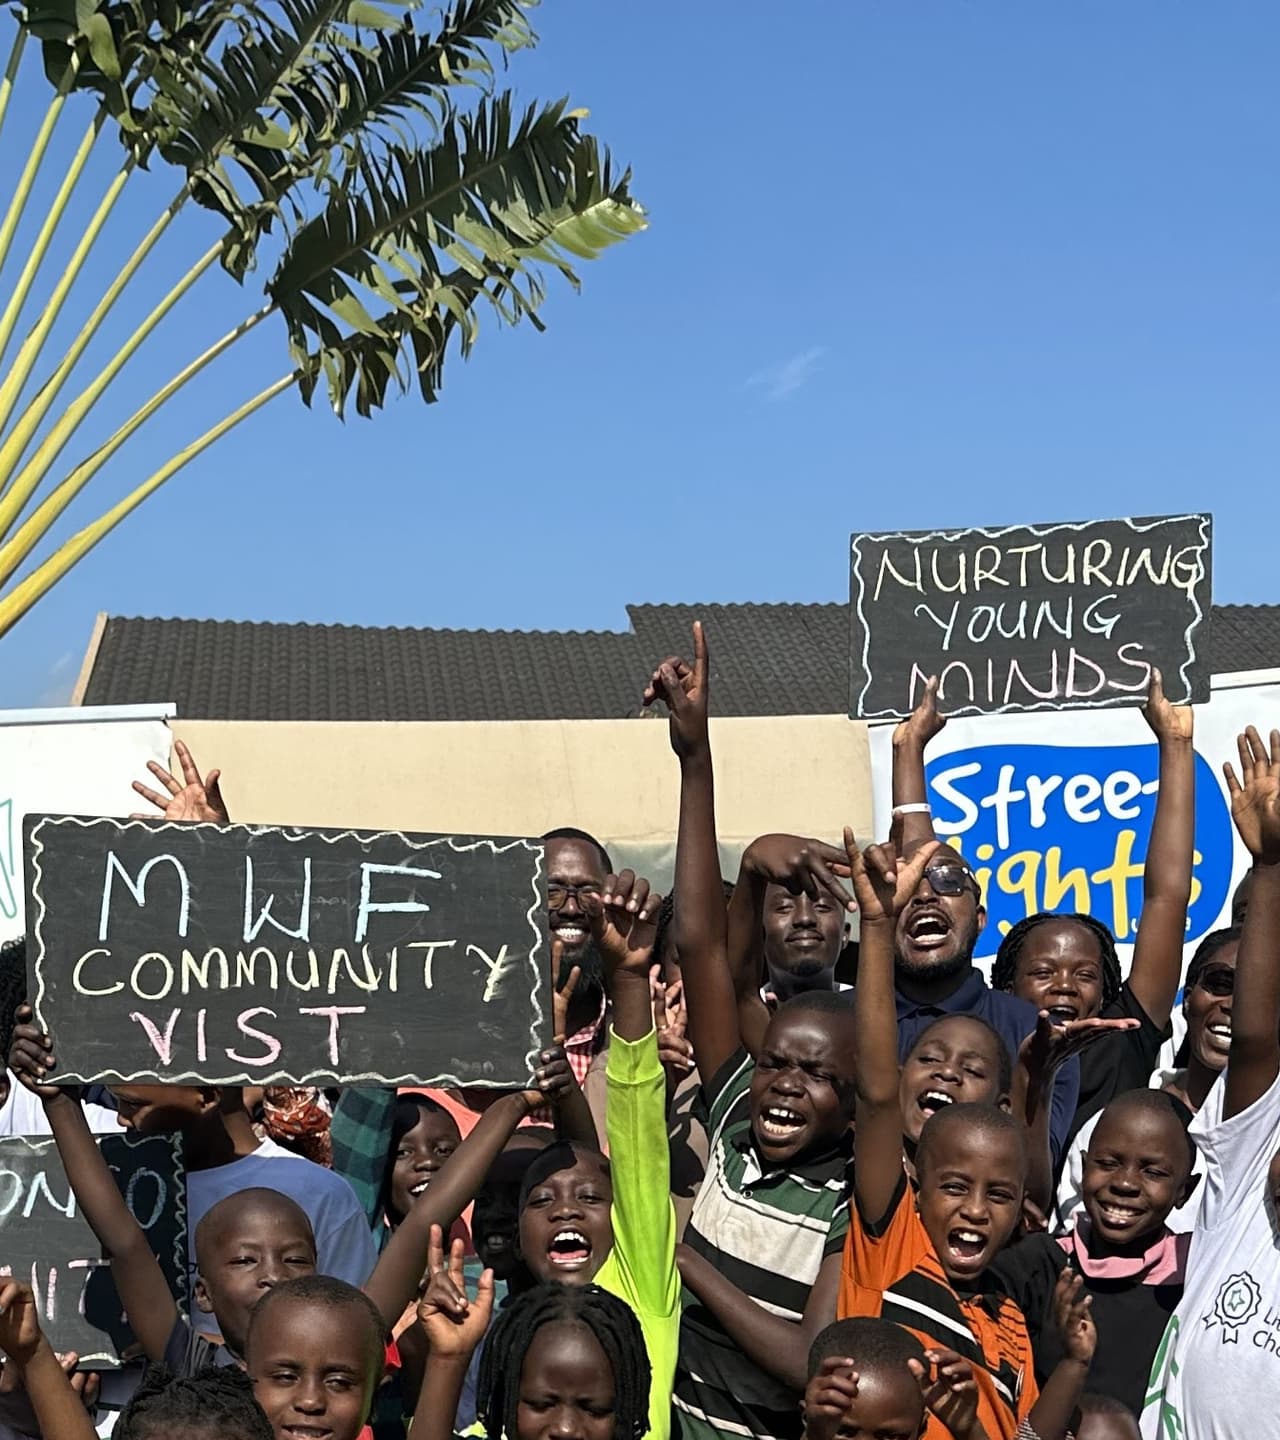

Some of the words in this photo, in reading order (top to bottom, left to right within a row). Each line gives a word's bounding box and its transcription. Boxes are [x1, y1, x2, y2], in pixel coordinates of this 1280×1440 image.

[874, 538, 1202, 600] NURTURING
[914, 594, 1122, 649] YOUNG
[909, 643, 1152, 709] MINDS
[930, 762, 1160, 850] Stree
[946, 829, 1203, 939] ight
[72, 939, 509, 1002] COMMUNITY
[130, 1005, 366, 1067] VIST
